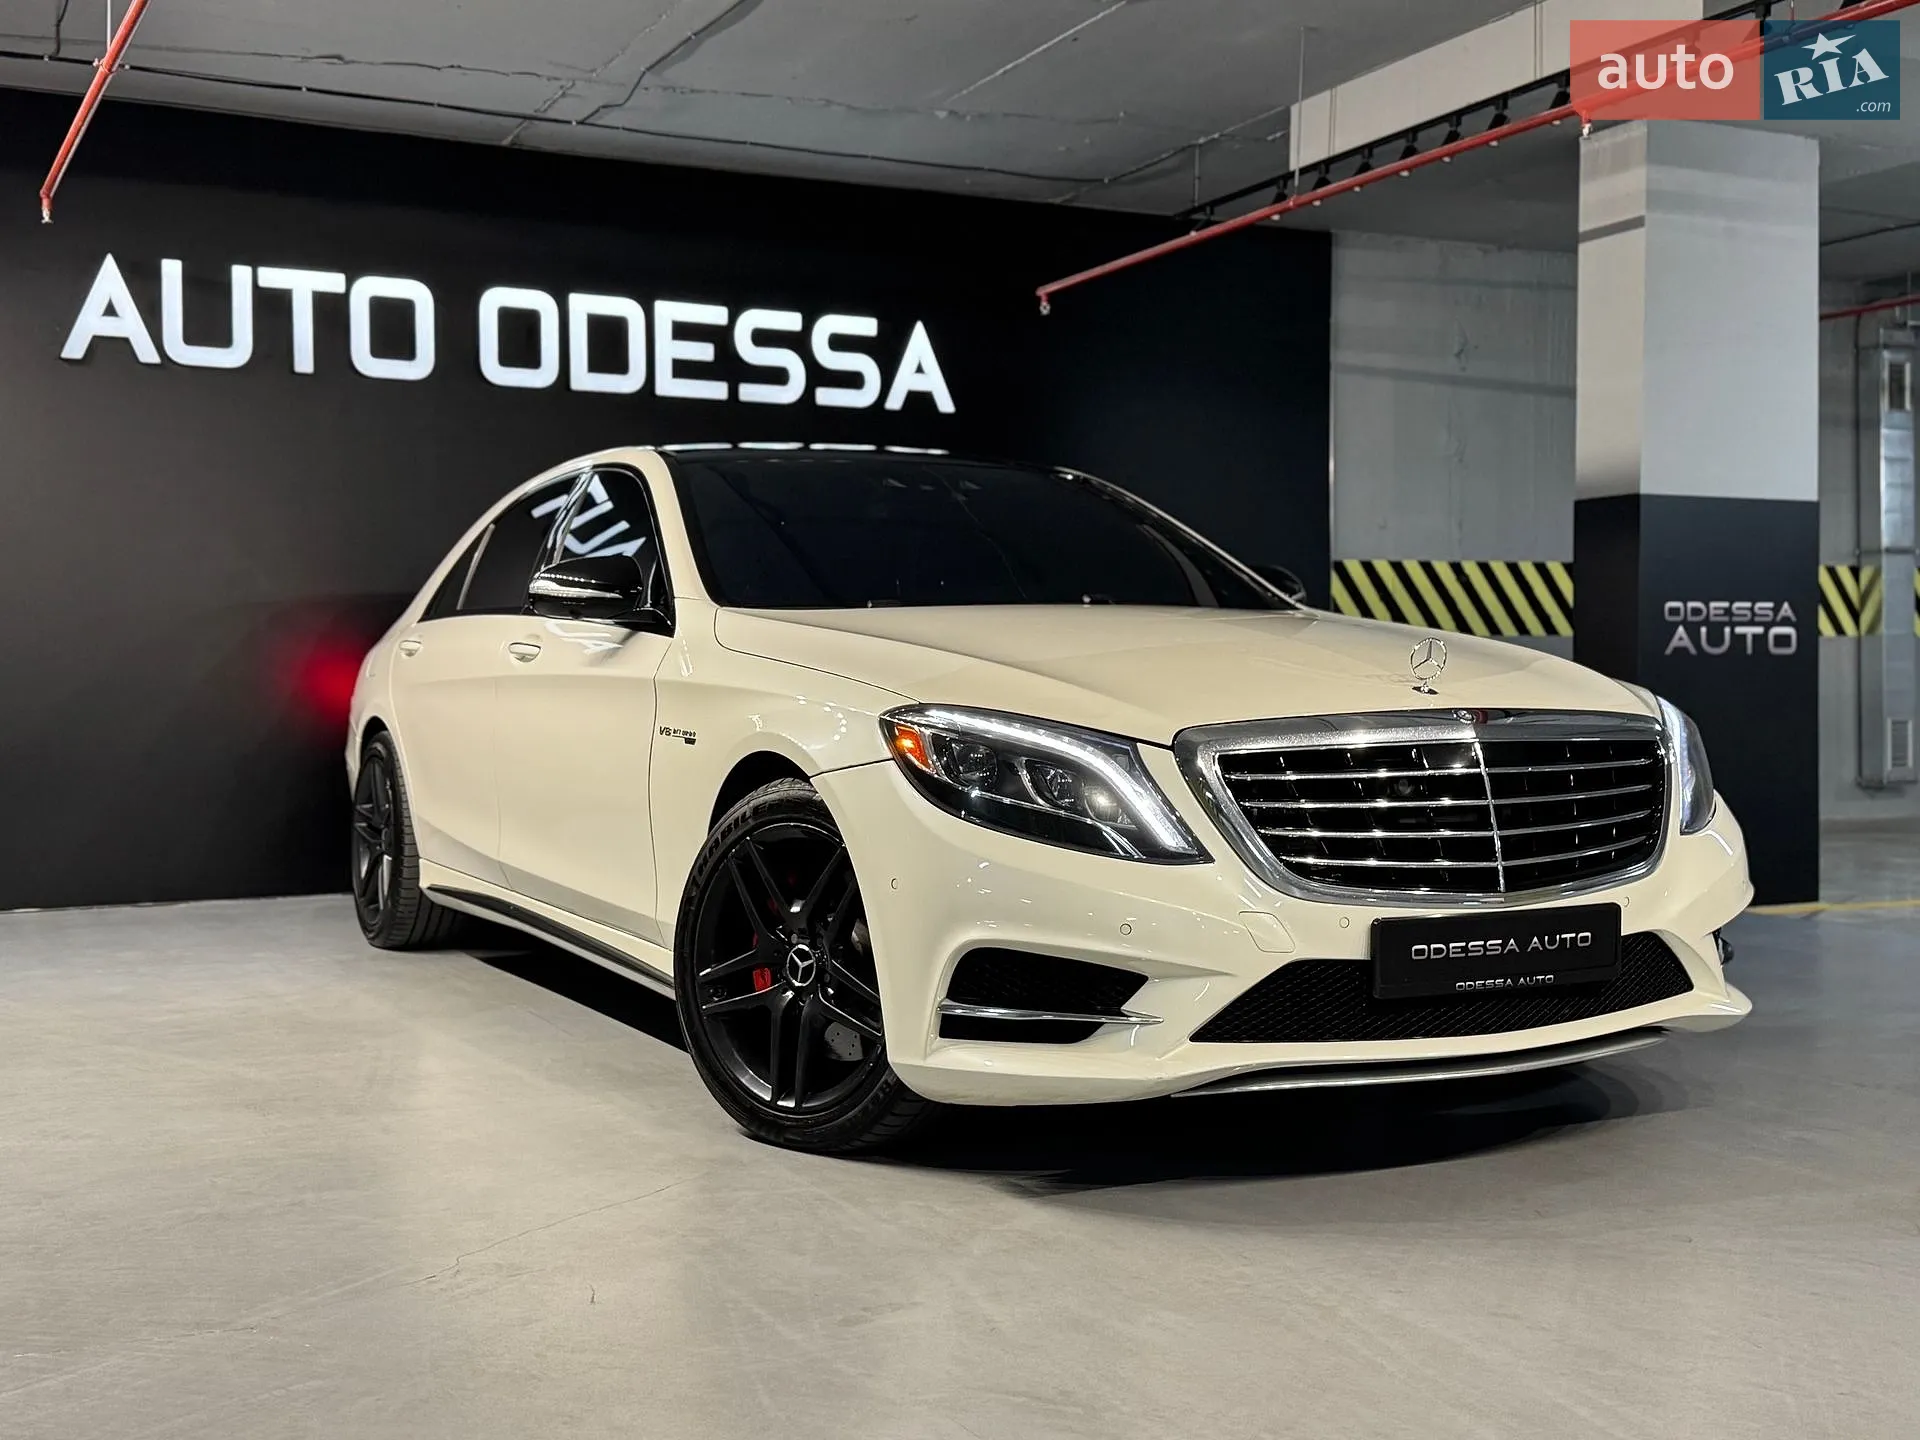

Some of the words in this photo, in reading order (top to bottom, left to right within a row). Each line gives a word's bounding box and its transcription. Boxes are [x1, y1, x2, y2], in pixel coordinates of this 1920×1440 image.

[59, 252, 436, 381] AUTO
[478, 286, 956, 414] ODESSA
[1664, 600, 1797, 622] ODESSA
[1664, 624, 1797, 656] AUTO
[1411, 938, 1520, 960] ODESSA
[1527, 931, 1592, 953] AUTO
[1455, 978, 1513, 991] ODESSA
[1517, 974, 1555, 986] AUTO
